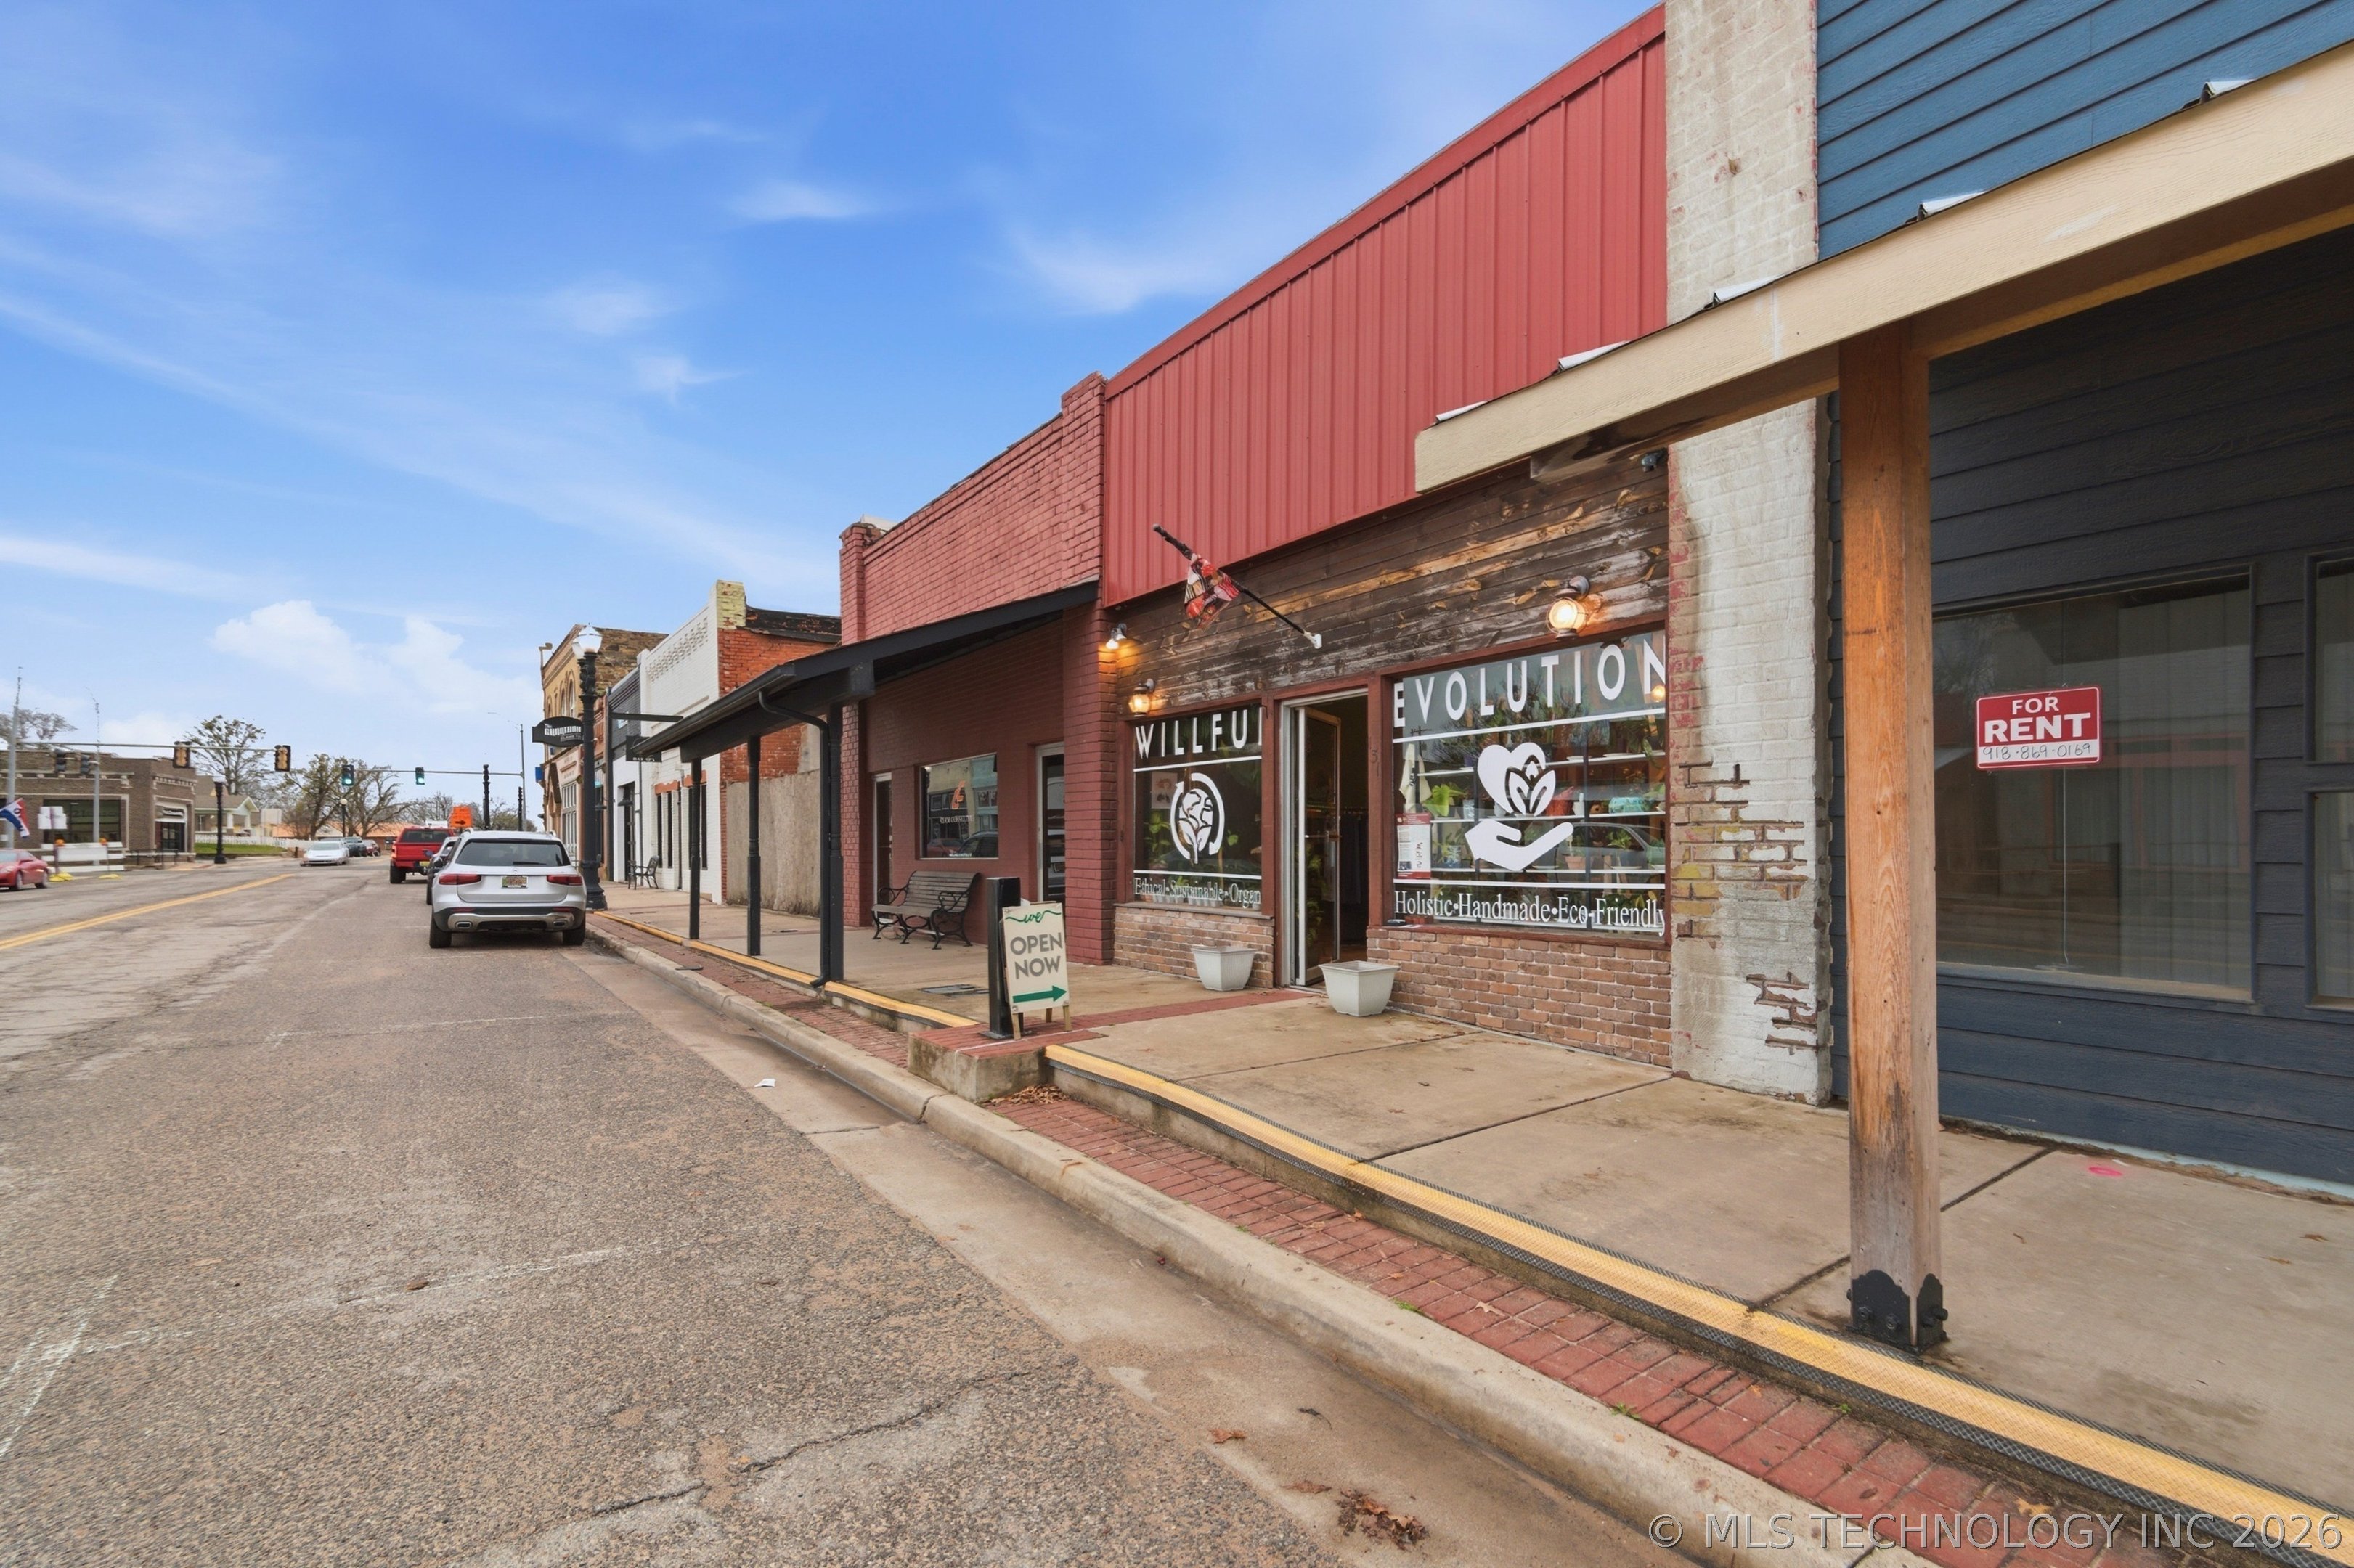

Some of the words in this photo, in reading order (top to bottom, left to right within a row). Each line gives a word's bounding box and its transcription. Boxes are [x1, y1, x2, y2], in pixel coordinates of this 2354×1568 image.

[1393, 634, 1666, 728] EVOLUTION
[2012, 696, 2059, 715] FOR
[1984, 712, 2091, 743] RENT
[1557, 897, 1666, 937] Eco-Friendly
[1010, 932, 1063, 955] OPEN
[1014, 955, 1061, 979] NOW
